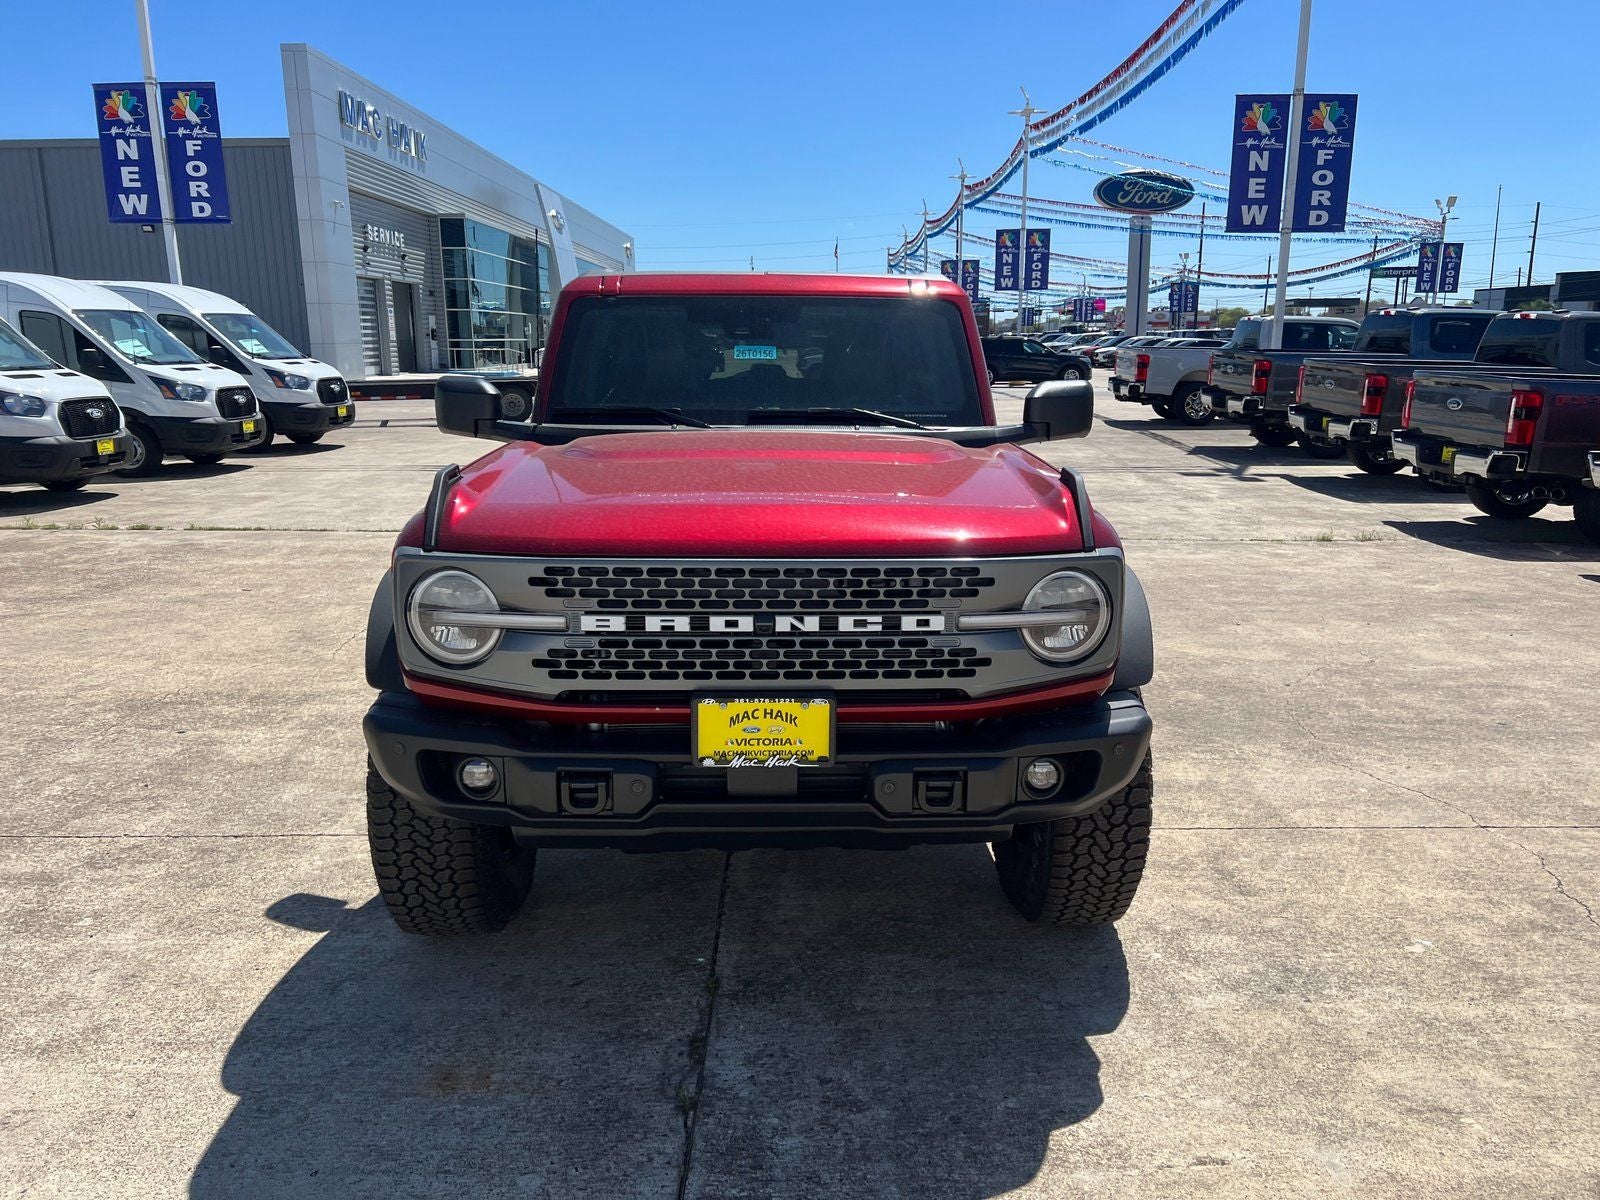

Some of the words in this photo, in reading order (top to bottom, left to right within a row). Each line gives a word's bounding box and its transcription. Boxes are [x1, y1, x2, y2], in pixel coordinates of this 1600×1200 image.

[338, 89, 382, 140] MAC
[386, 114, 428, 160] HAIK
[115, 138, 149, 215] NEW
[185, 140, 213, 218] FORD
[1241, 150, 1270, 226] NEW
[1308, 149, 1335, 226] FORD
[1117, 179, 1174, 204] Ford
[366, 224, 405, 247] SERVICE
[1000, 253, 1014, 288] NEW
[1031, 253, 1042, 288] FORD
[1420, 262, 1432, 291] NEW
[1444, 262, 1455, 291] FORD
[736, 349, 774, 358] 26T0156
[580, 615, 946, 632] BRONCO
[729, 708, 760, 728] MAC
[763, 708, 799, 728] HAIK
[713, 749, 815, 757] MACHAIKVICTORIA.COM
[735, 737, 793, 746] VICTORIA
[728, 754, 759, 768] Mac
[763, 754, 801, 768] Haik
